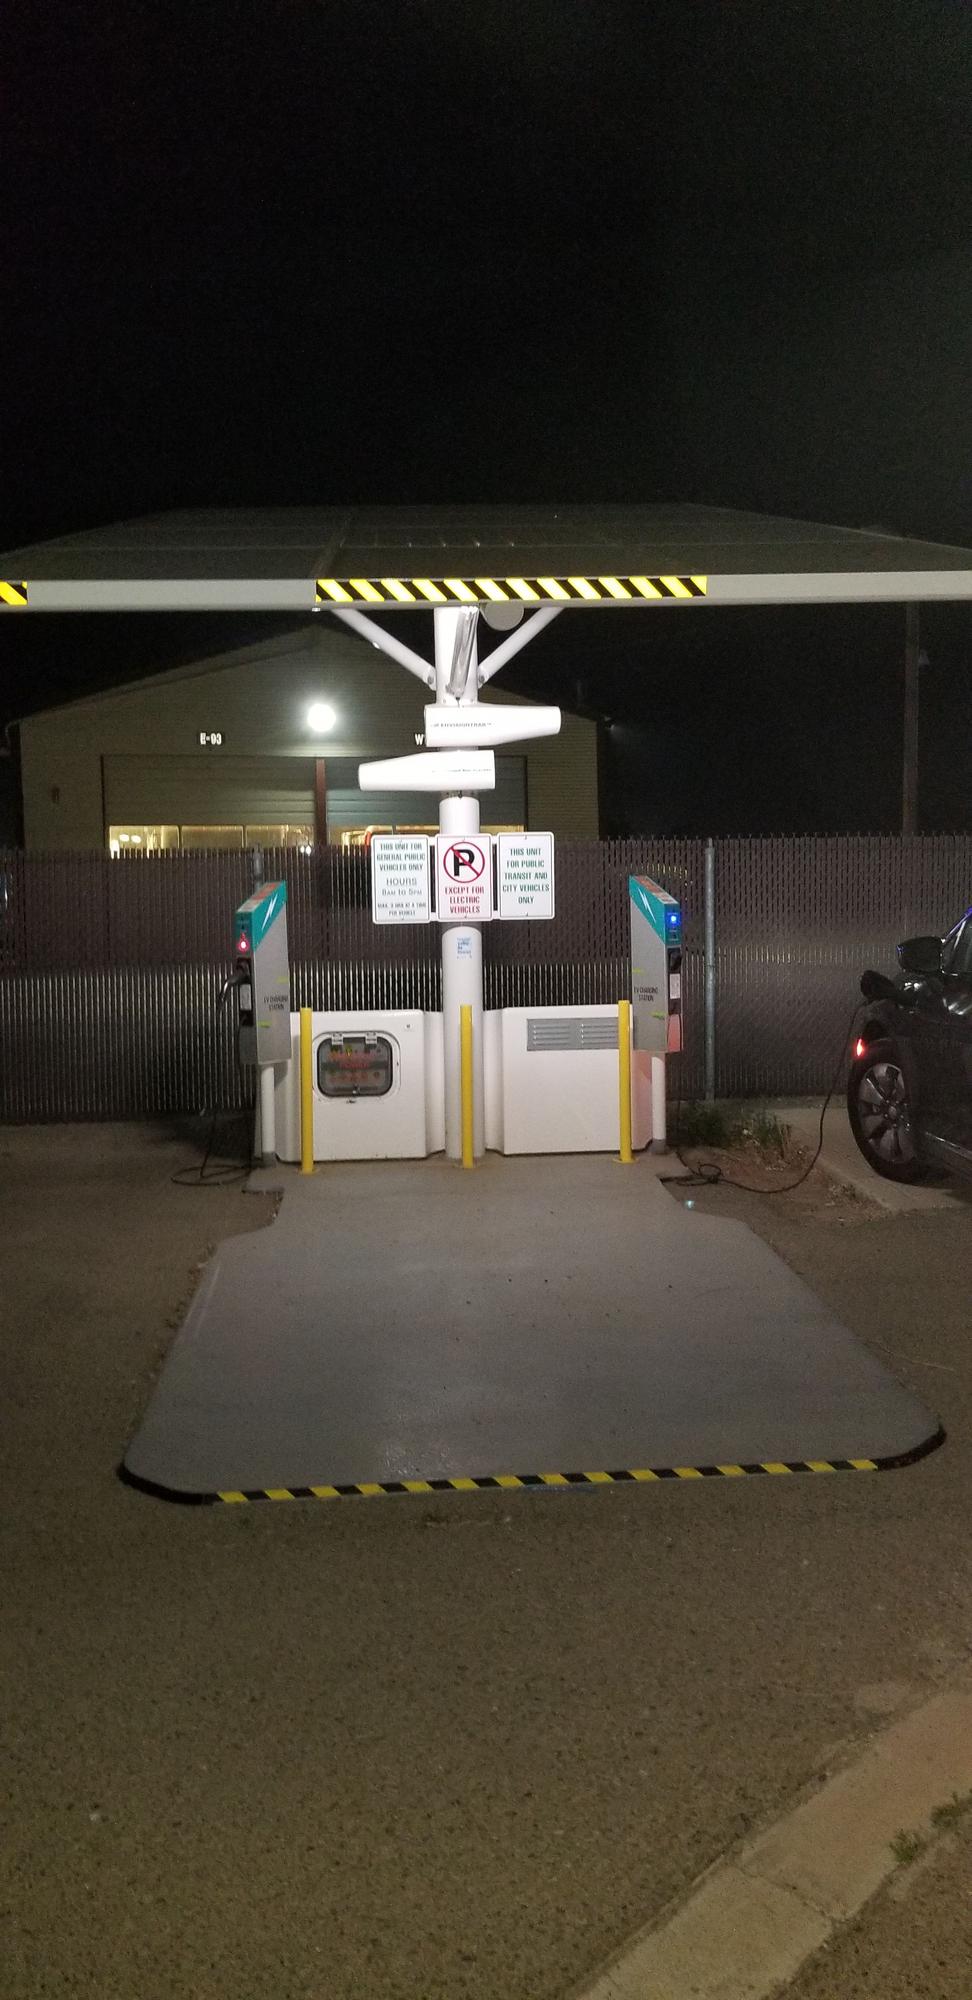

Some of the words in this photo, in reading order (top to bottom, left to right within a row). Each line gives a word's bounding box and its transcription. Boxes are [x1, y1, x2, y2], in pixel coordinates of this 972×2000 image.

[200, 732, 222, 745] E-03
[380, 842, 393, 851] THIS
[395, 842, 409, 850] UNIT
[411, 842, 423, 850] FOR
[510, 848, 525, 856] THIS
[526, 848, 541, 856] UNIT
[376, 853, 402, 861] GENERAL
[404, 853, 426, 861] PUBLIC
[379, 863, 407, 871] VEHICLES
[408, 863, 423, 871] ONLY
[506, 860, 520, 868] FOR
[521, 860, 545, 868] PUBLIC
[504, 872, 532, 880] TRANSIT
[534, 872, 548, 880] AND
[386, 877, 417, 886] HOURS
[444, 886, 469, 895] EXCEPT
[472, 886, 484, 894] FOR
[502, 884, 518, 893] CITY
[519, 884, 550, 892] VEHICLES
[449, 896, 480, 904] ELECTRIC
[518, 896, 534, 904] ONLY
[450, 905, 481, 914] VEHICLES
